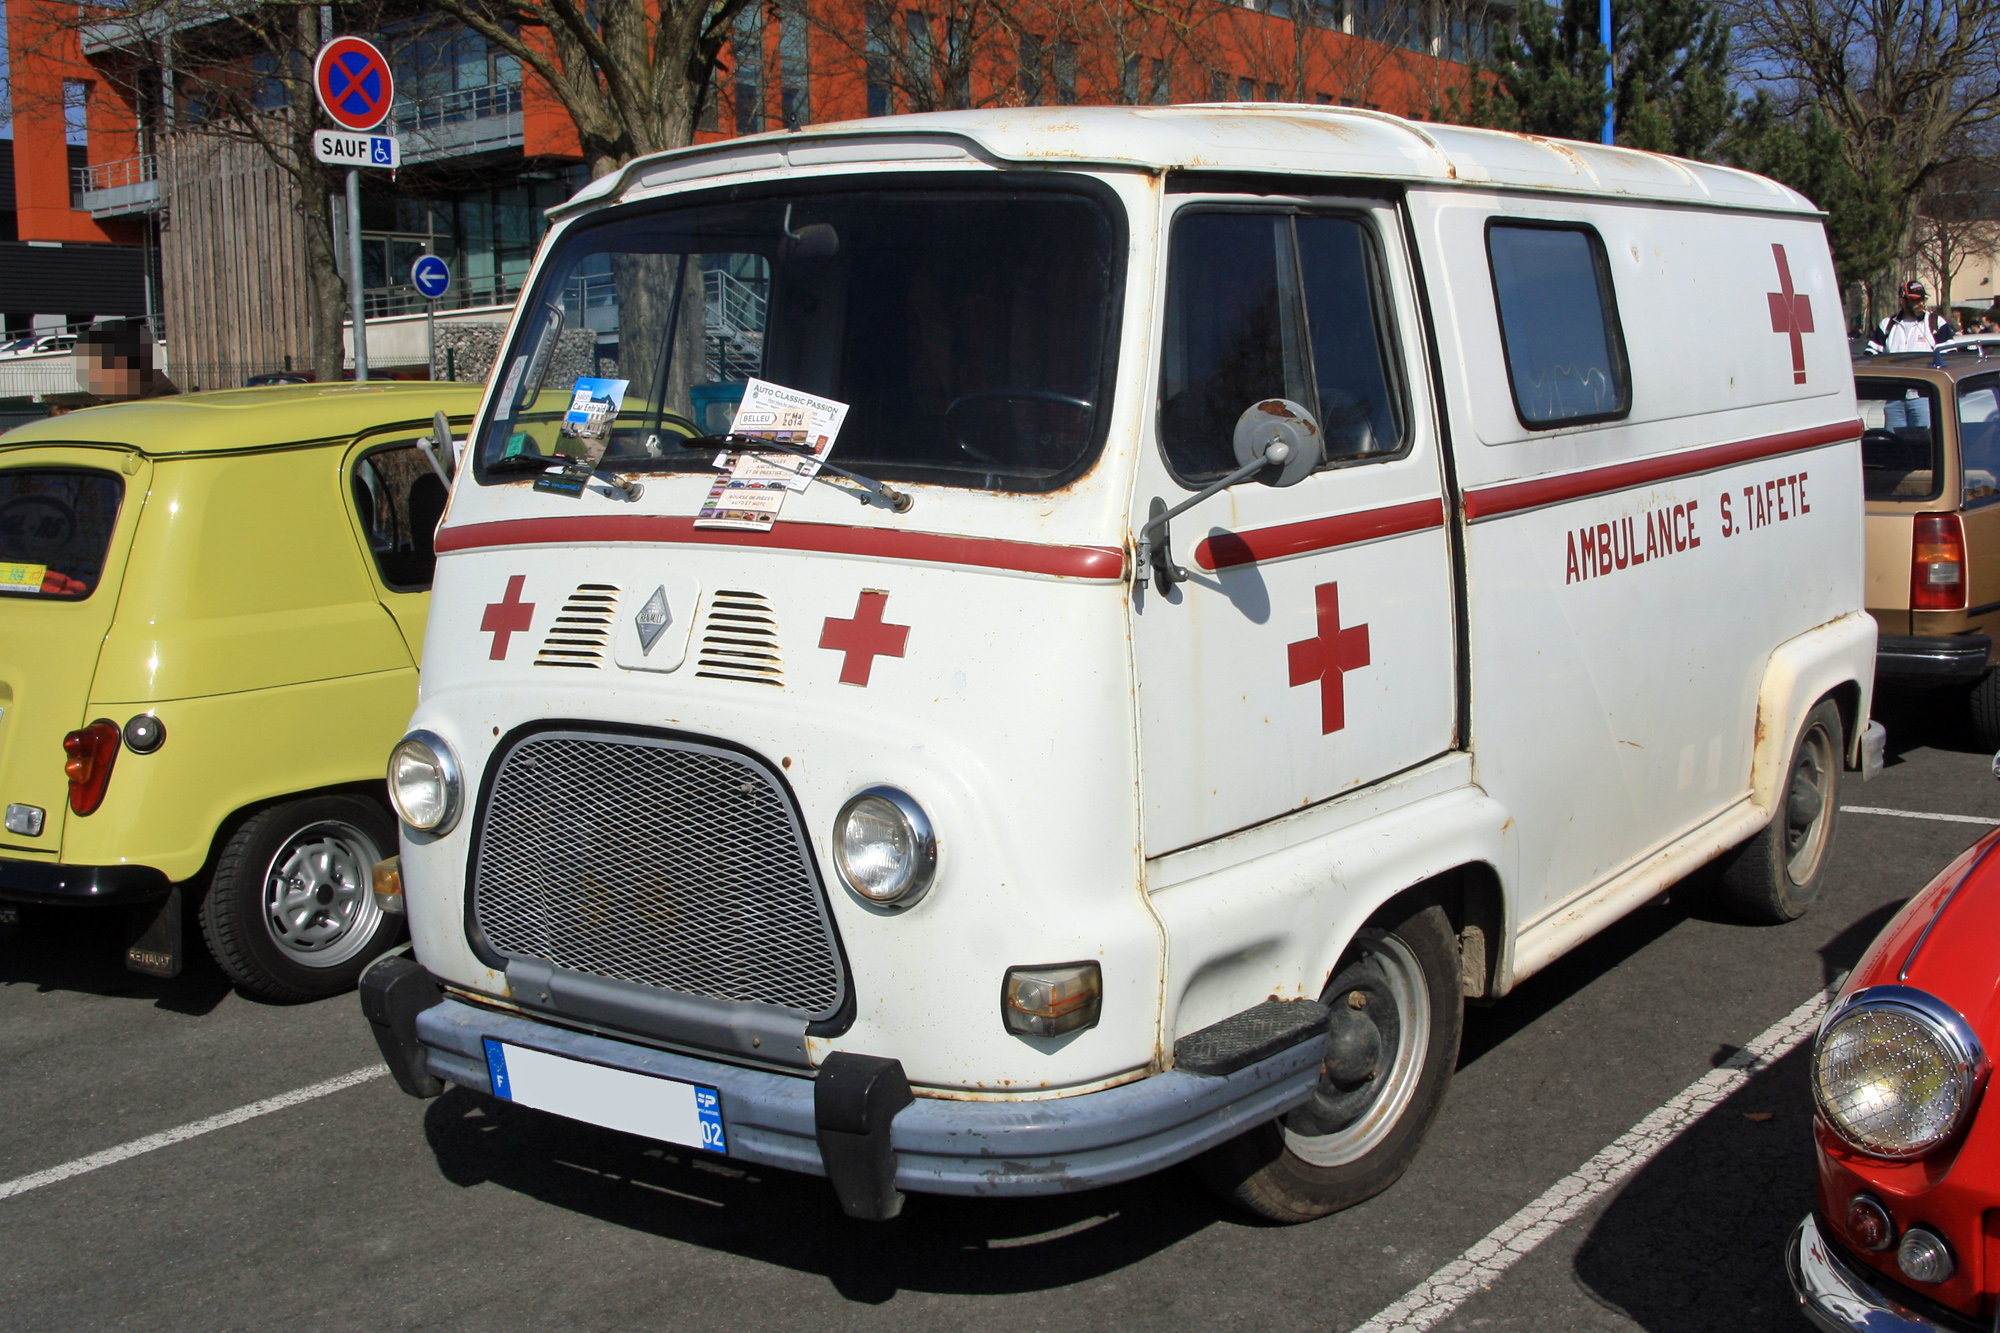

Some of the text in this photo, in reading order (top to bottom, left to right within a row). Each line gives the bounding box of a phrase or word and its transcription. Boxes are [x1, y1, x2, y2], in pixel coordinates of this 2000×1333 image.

[322, 137, 367, 158] SAUF
[753, 384, 774, 396] AUTO
[774, 390, 806, 405] CLASSIC
[806, 399, 839, 414] PASSION
[742, 413, 771, 423] BELLEU
[1565, 471, 1811, 585] AMBULANCE S. TAFETE
[639, 612, 664, 623] RENAULT
[129, 949, 171, 966] RENAULT
[496, 1074, 504, 1088] F
[701, 1120, 724, 1147] 02
